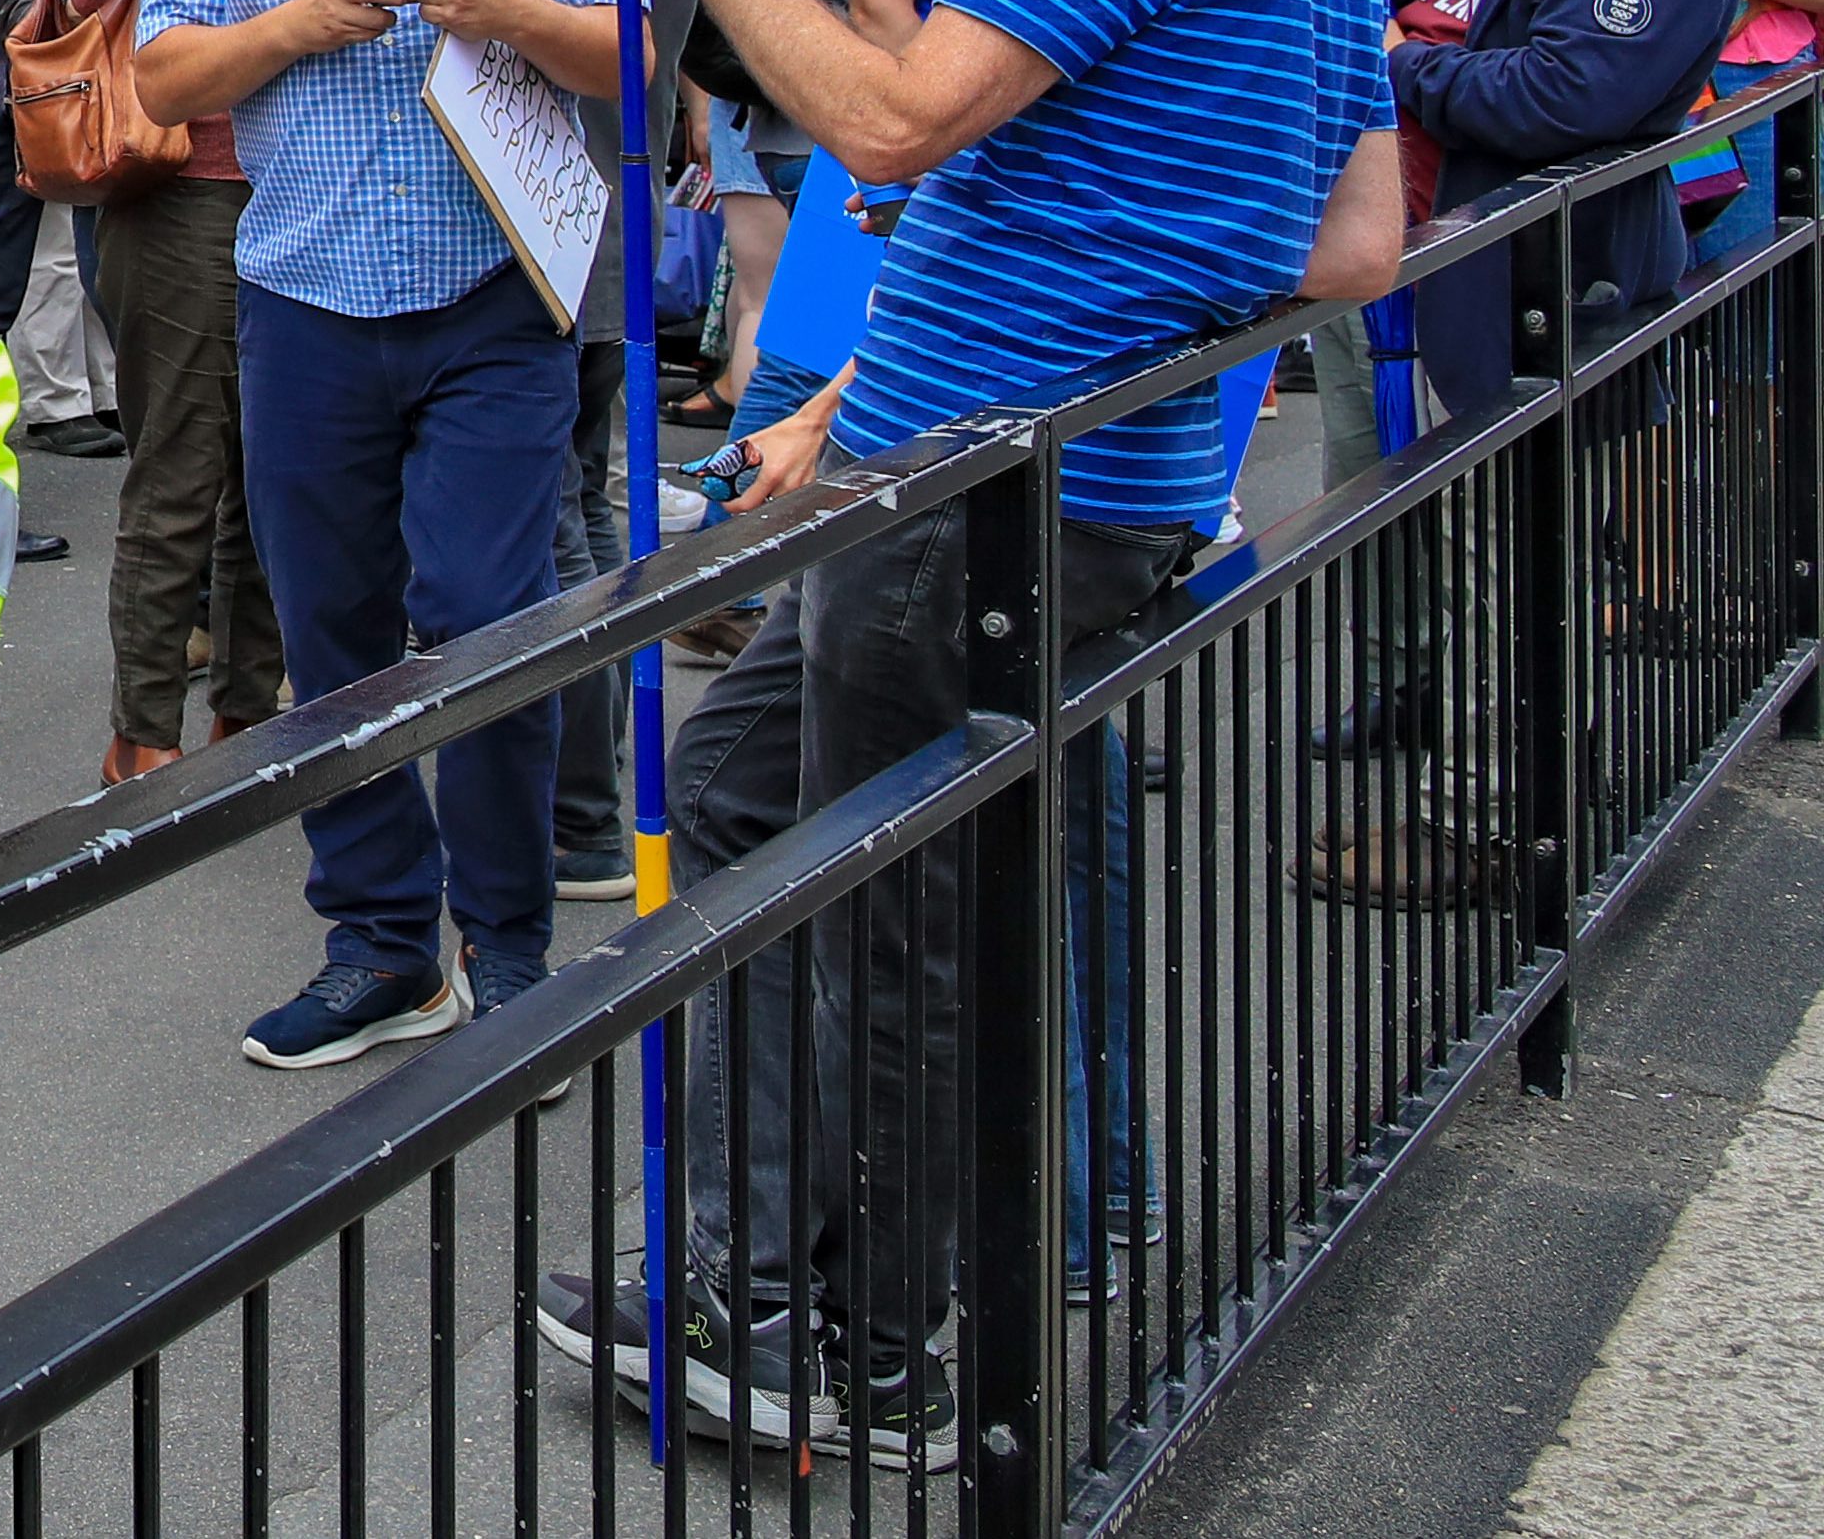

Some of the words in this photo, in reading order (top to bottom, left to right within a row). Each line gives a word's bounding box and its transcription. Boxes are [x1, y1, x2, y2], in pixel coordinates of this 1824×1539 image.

[467, 67, 505, 140] YES
[503, 128, 566, 249] PLEASE
[479, 39, 554, 169] BREXIT
[553, 165, 598, 246] GOES
[562, 134, 608, 216] GOES
